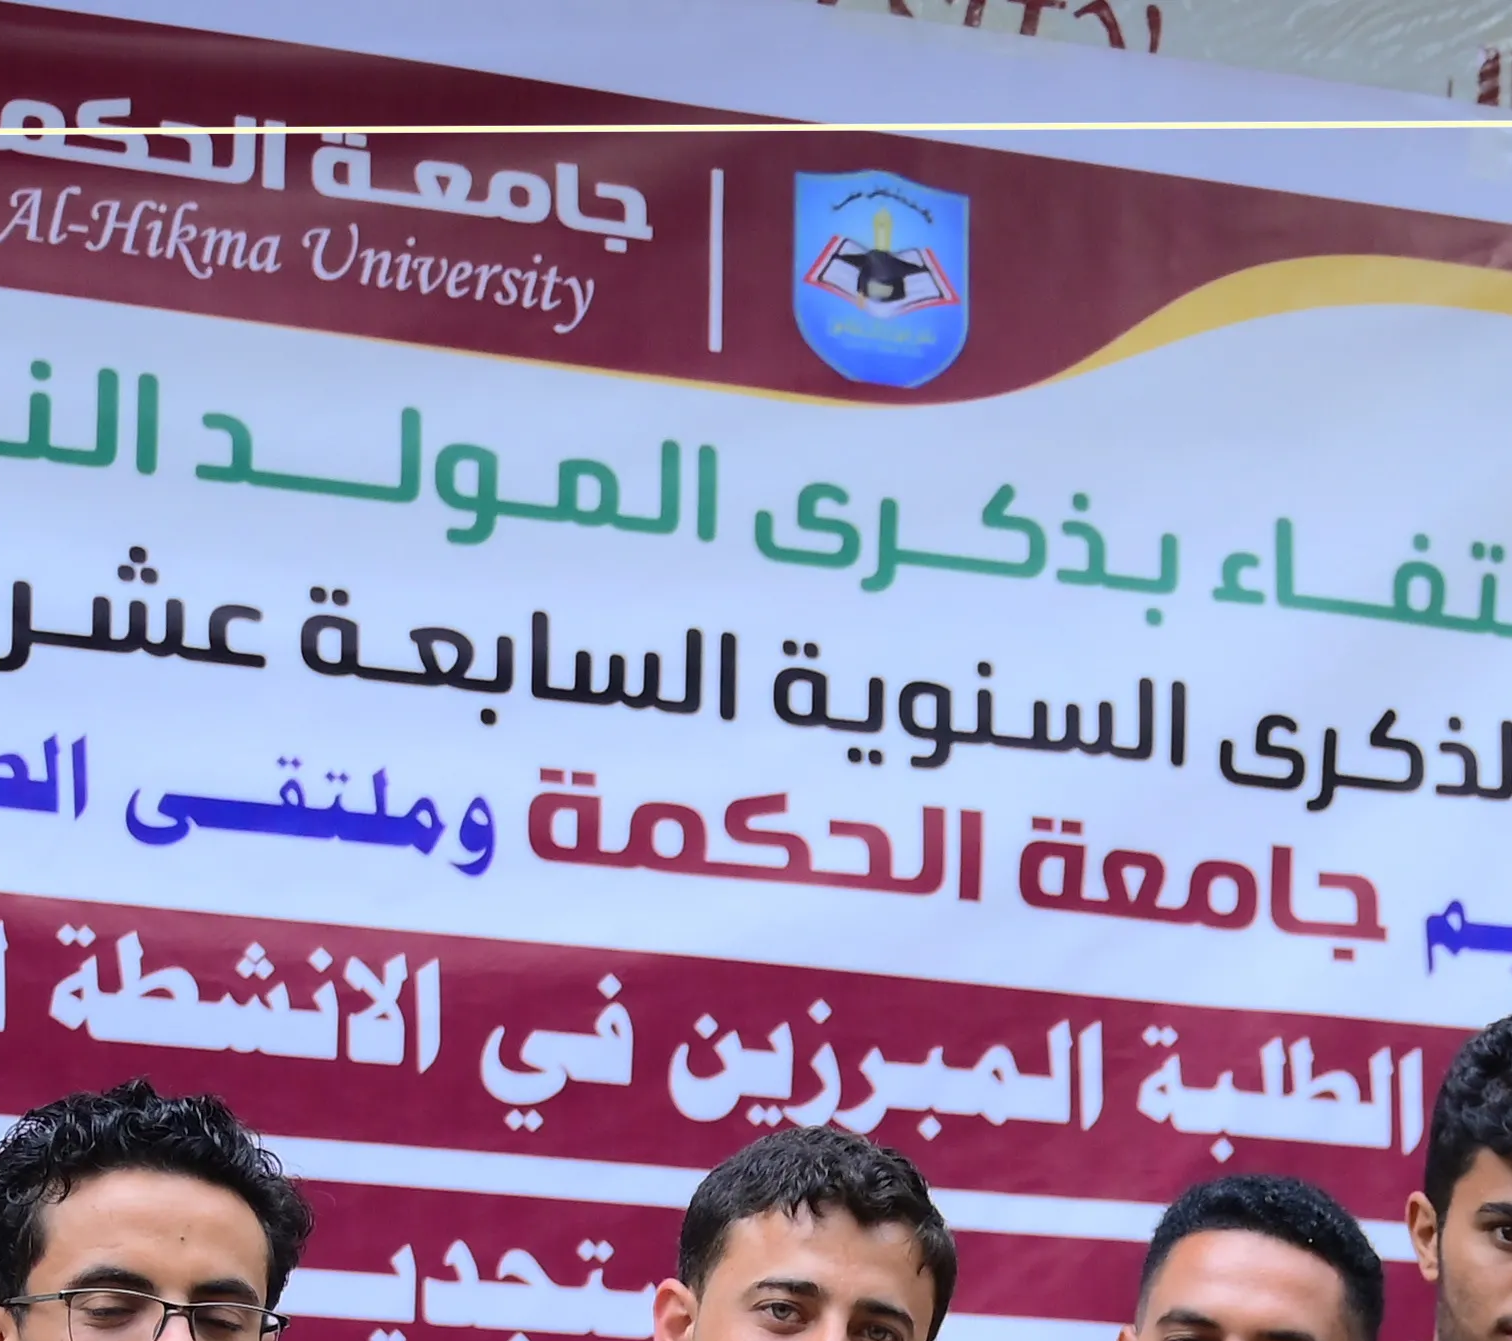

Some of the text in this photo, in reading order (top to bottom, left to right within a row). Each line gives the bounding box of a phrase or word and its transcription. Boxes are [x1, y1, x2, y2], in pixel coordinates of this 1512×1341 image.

[312, 132, 656, 255] جامعة
[301, 225, 598, 335] University
[195, 408, 718, 547] المولد
[755, 482, 1179, 626] بذكرى
[300, 584, 737, 727] السابعة
[773, 640, 1188, 769] السنوية
[125, 759, 496, 877] وملتقى
[527, 766, 984, 905] الحكمة
[1019, 815, 1388, 963] جامعة
[50, 914, 443, 1076] الانشطة
[479, 971, 634, 1131] في
[669, 998, 1104, 1138] المبرزين
[1136, 1022, 1425, 1164] الطلبة
